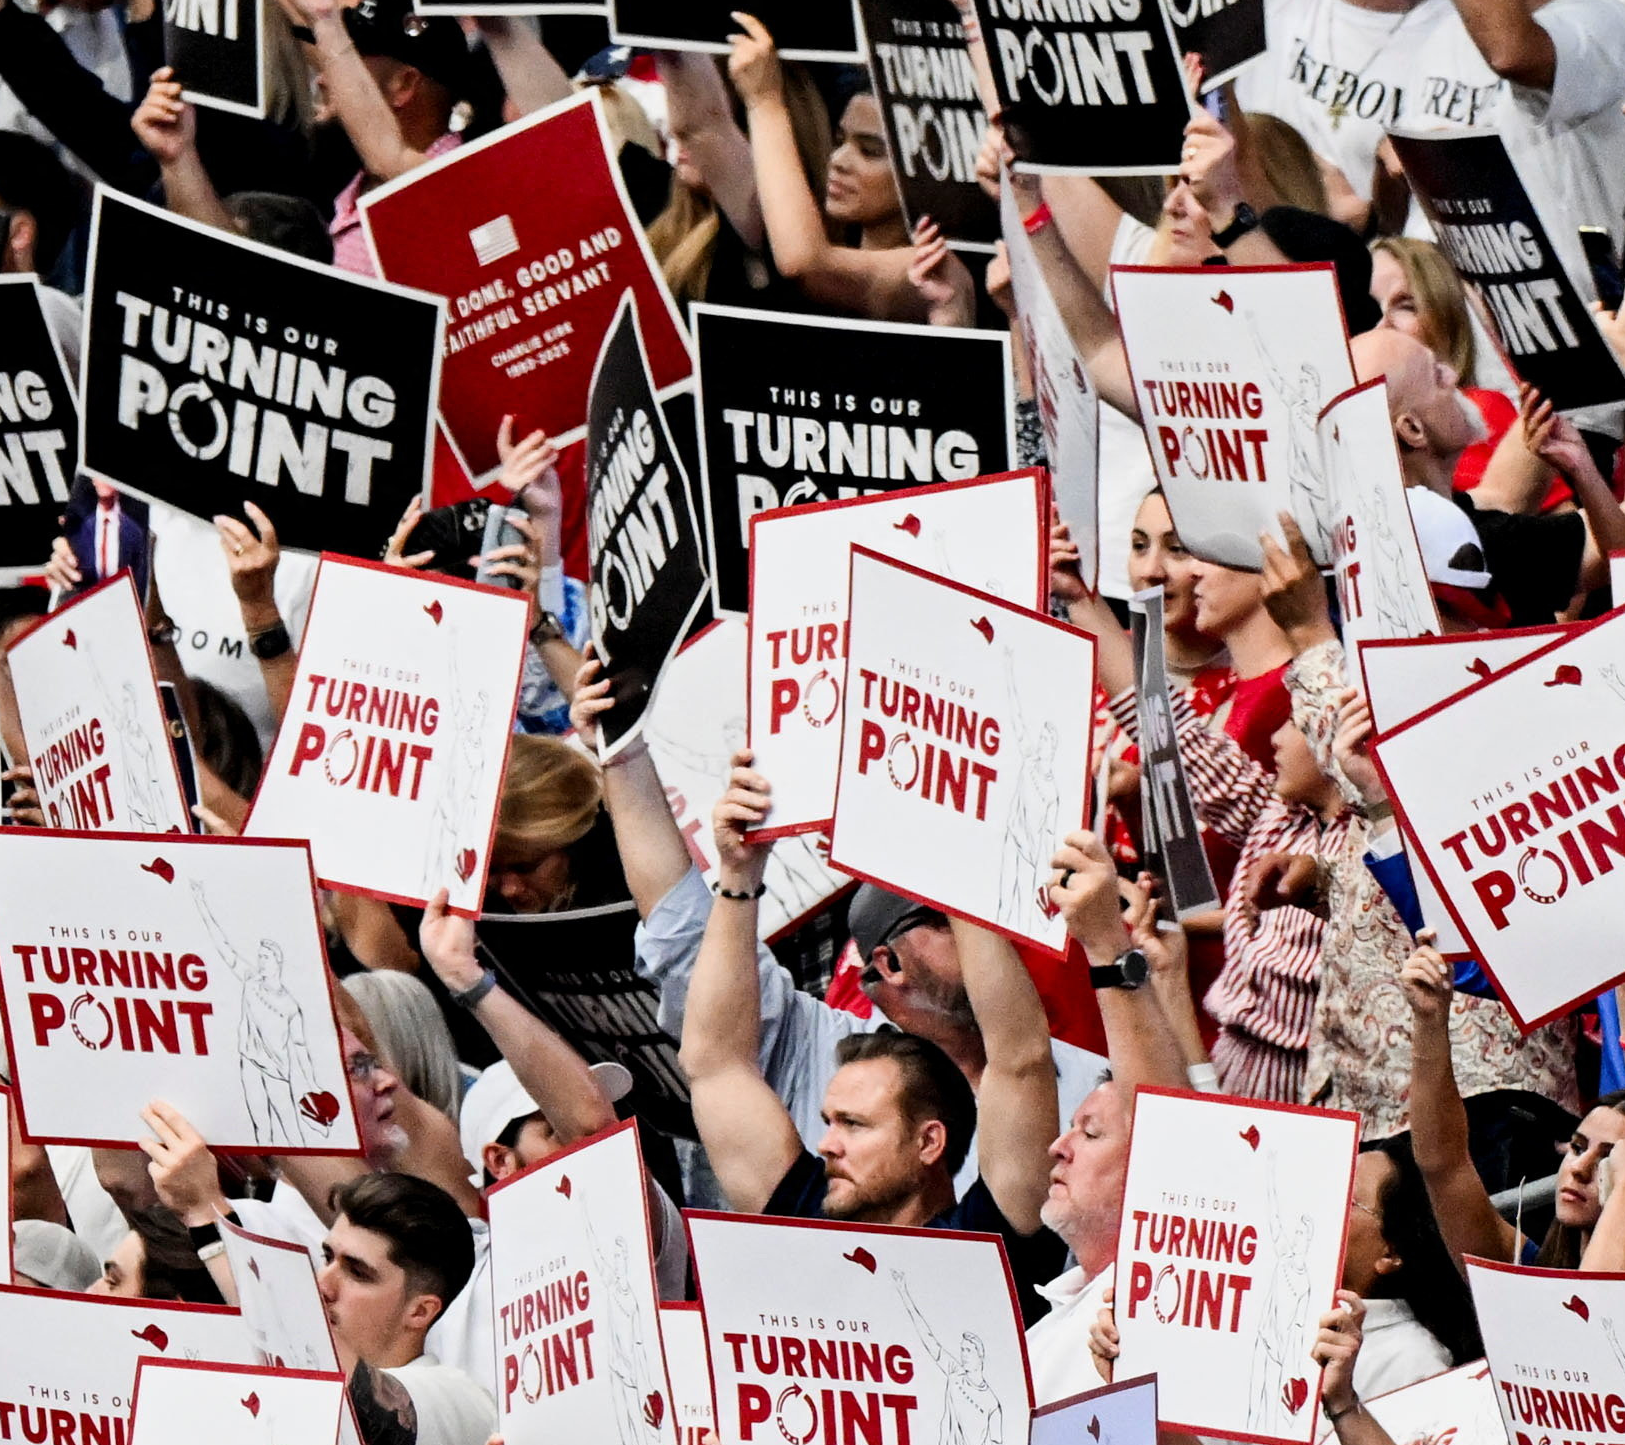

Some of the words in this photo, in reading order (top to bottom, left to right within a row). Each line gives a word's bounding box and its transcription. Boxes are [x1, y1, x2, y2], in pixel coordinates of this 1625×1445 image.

[173, 286, 229, 321] THIS
[245, 311, 267, 334] IS
[284, 325, 338, 355] OUR
[115, 290, 395, 427] TURNING
[49, 927, 89, 939] THIS
[100, 928, 119, 940] IS
[128, 930, 162, 942] OUR
[13, 945, 208, 992] TURNING
[1162, 1192, 1188, 1206] THIS
[1195, 1196, 1206, 1209] IS
[1213, 1200, 1236, 1212] OUR
[1133, 1210, 1257, 1266] TURNING
